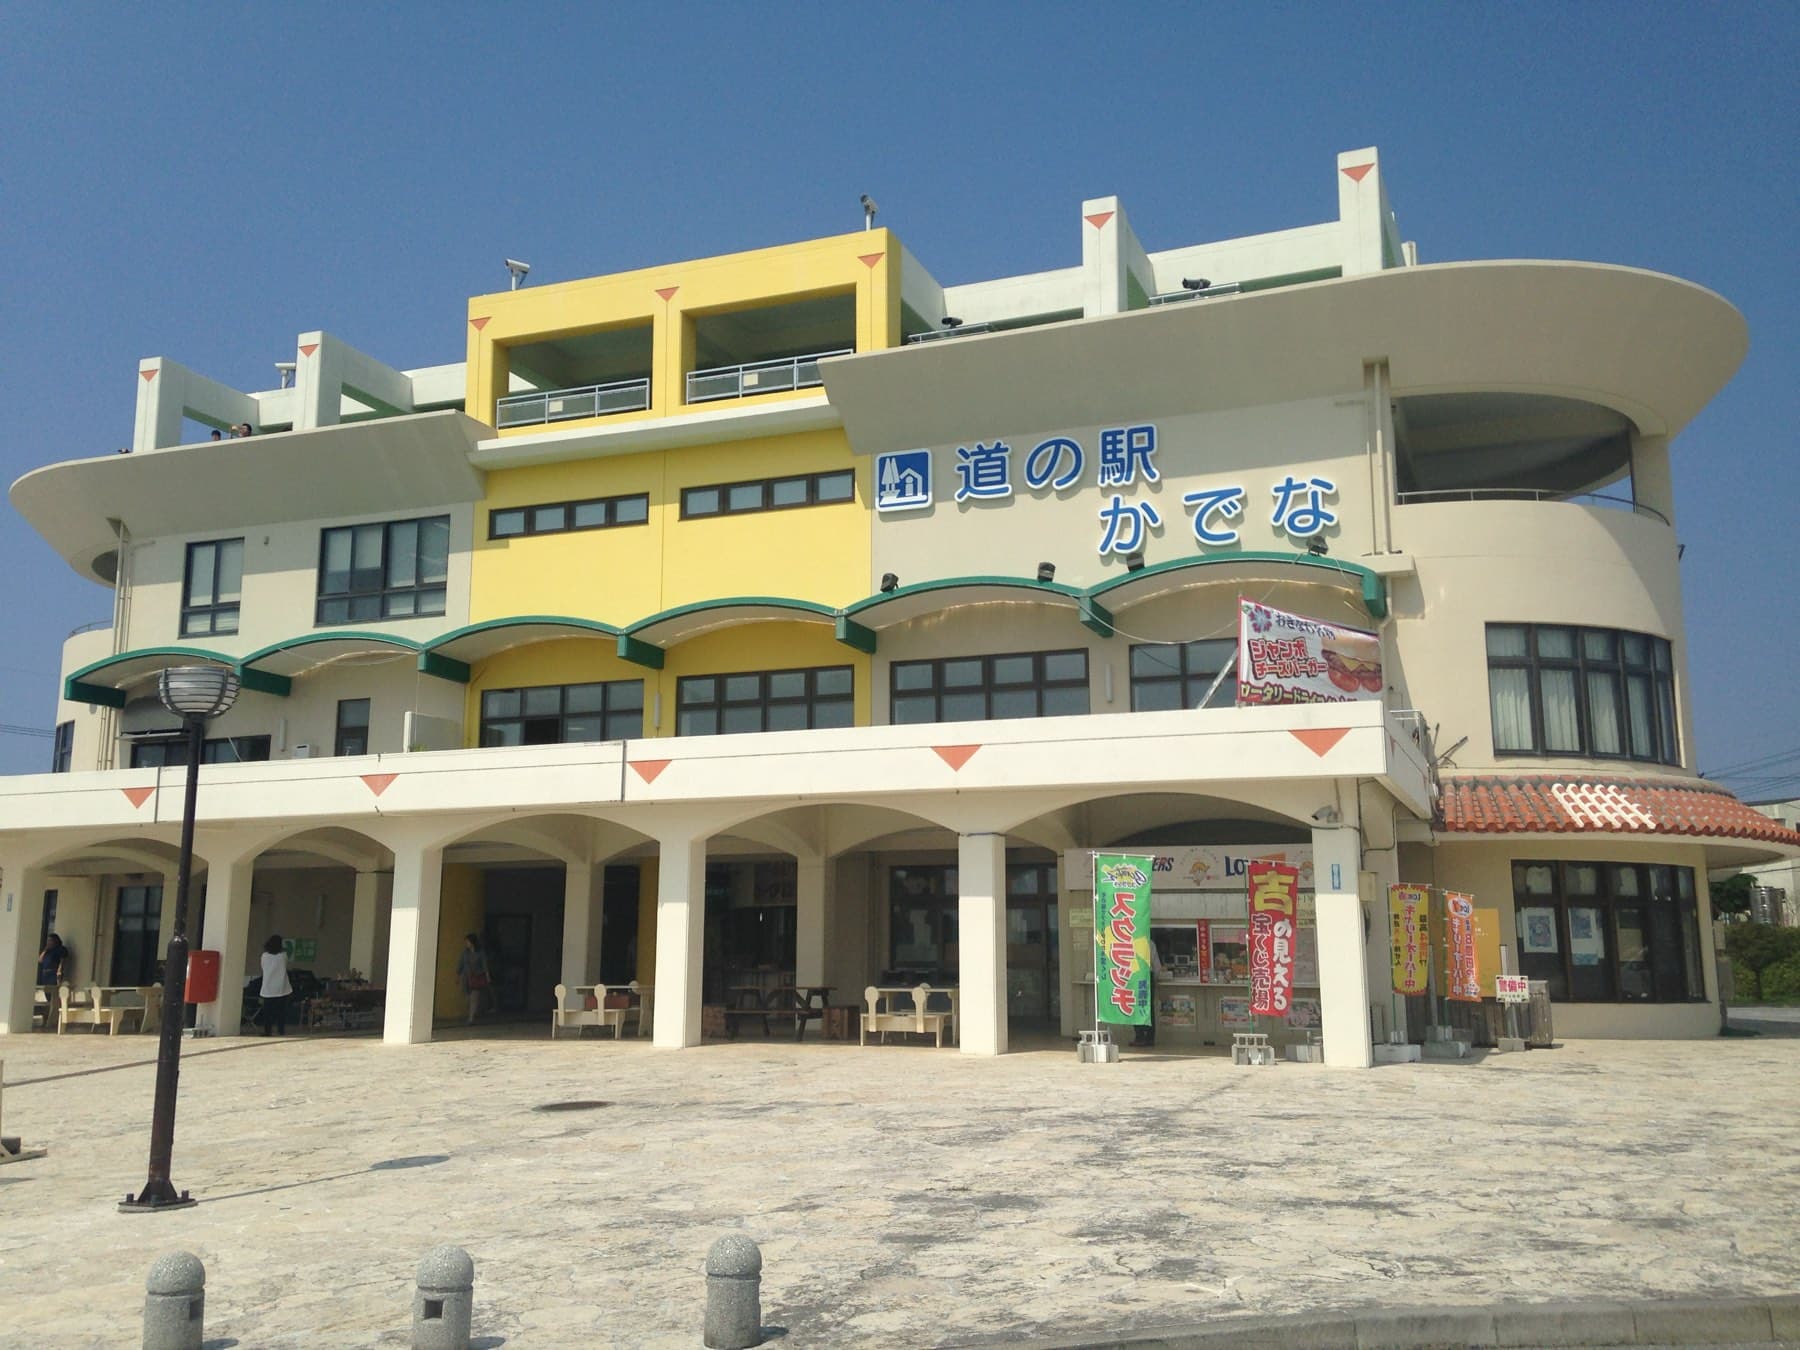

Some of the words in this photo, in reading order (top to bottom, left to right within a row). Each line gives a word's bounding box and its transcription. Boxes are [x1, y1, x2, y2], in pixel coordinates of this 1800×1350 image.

[955, 424, 1161, 502] 道の駅
[1098, 477, 1338, 556] かでな
[1249, 638, 1309, 661] ジャンボ
[1275, 612, 1336, 640] おきなわ名物
[1251, 913, 1272, 1010] 宝くじ売場
